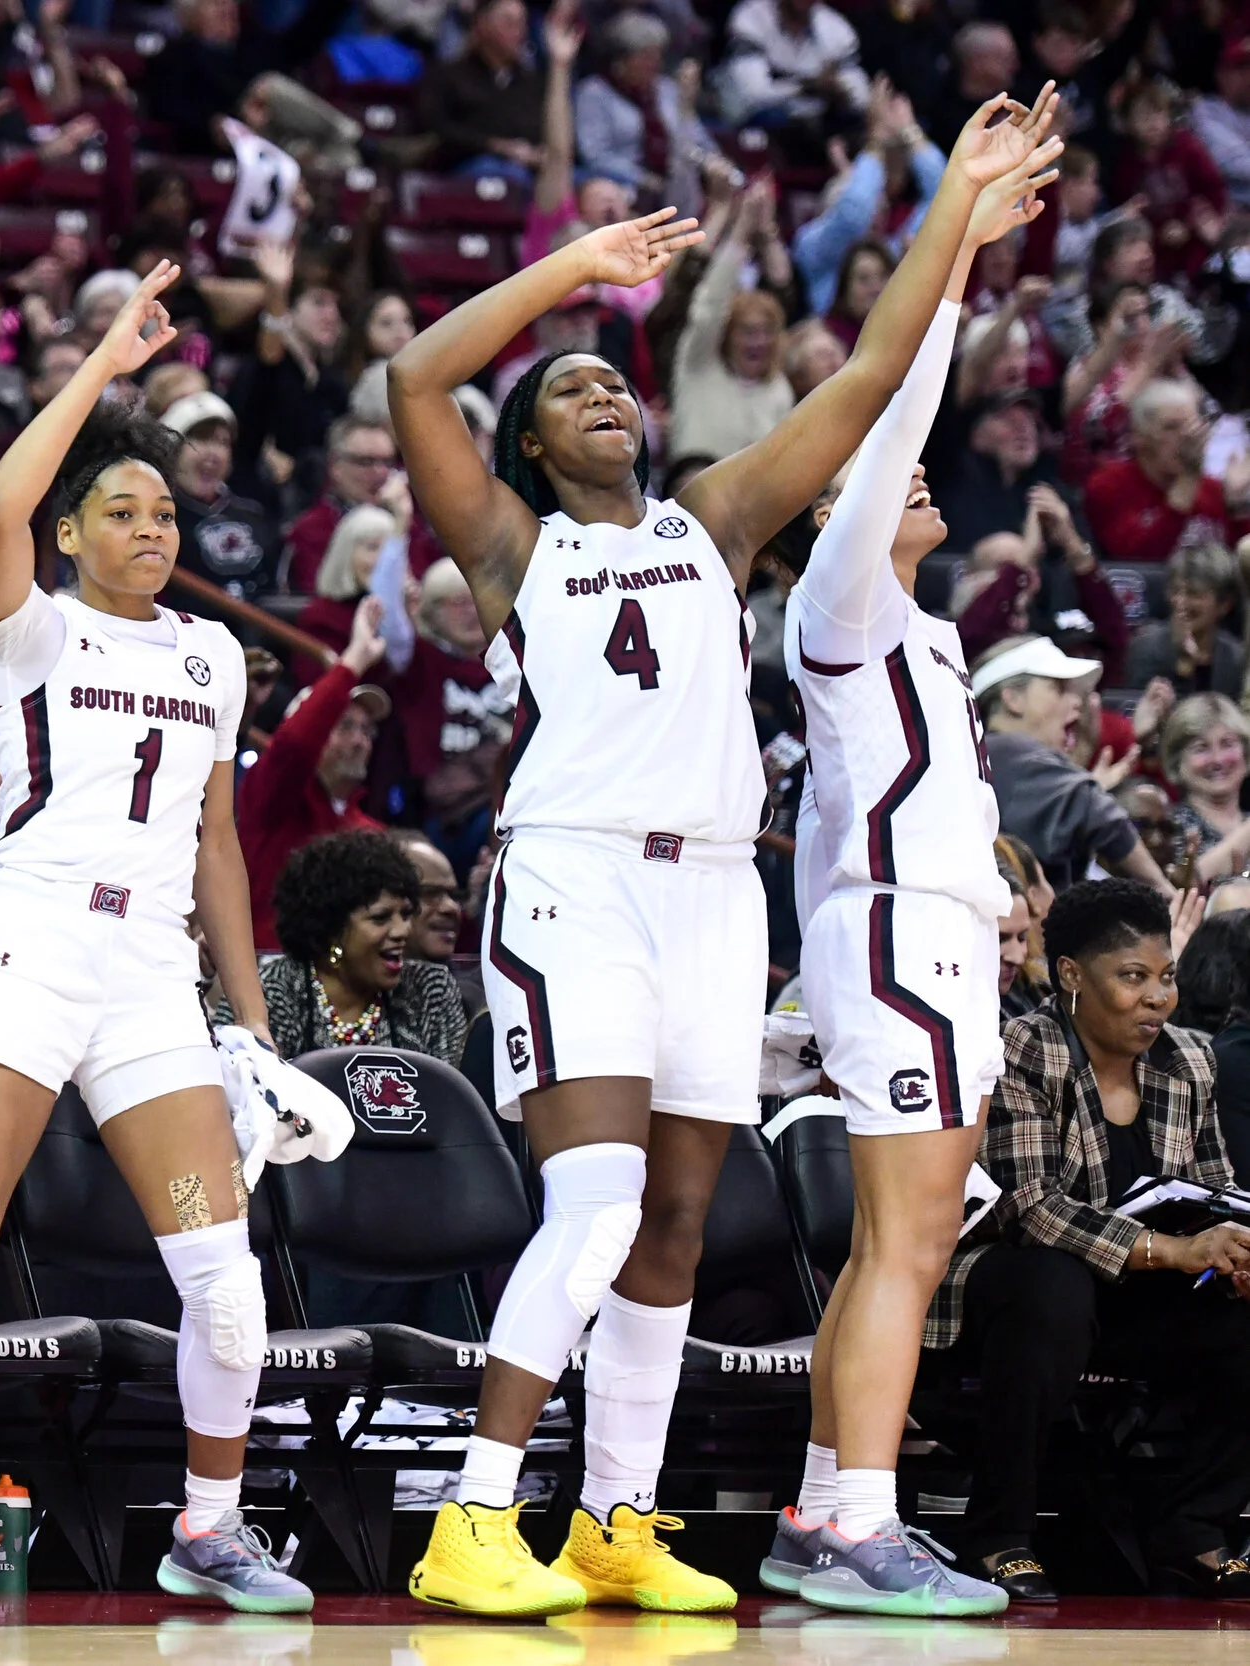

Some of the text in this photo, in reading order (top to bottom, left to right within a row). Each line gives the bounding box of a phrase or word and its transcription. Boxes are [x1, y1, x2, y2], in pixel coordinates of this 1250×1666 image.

[603, 598, 661, 690] 4
[70, 686, 135, 715] SOUTH
[128, 727, 163, 824] 1
